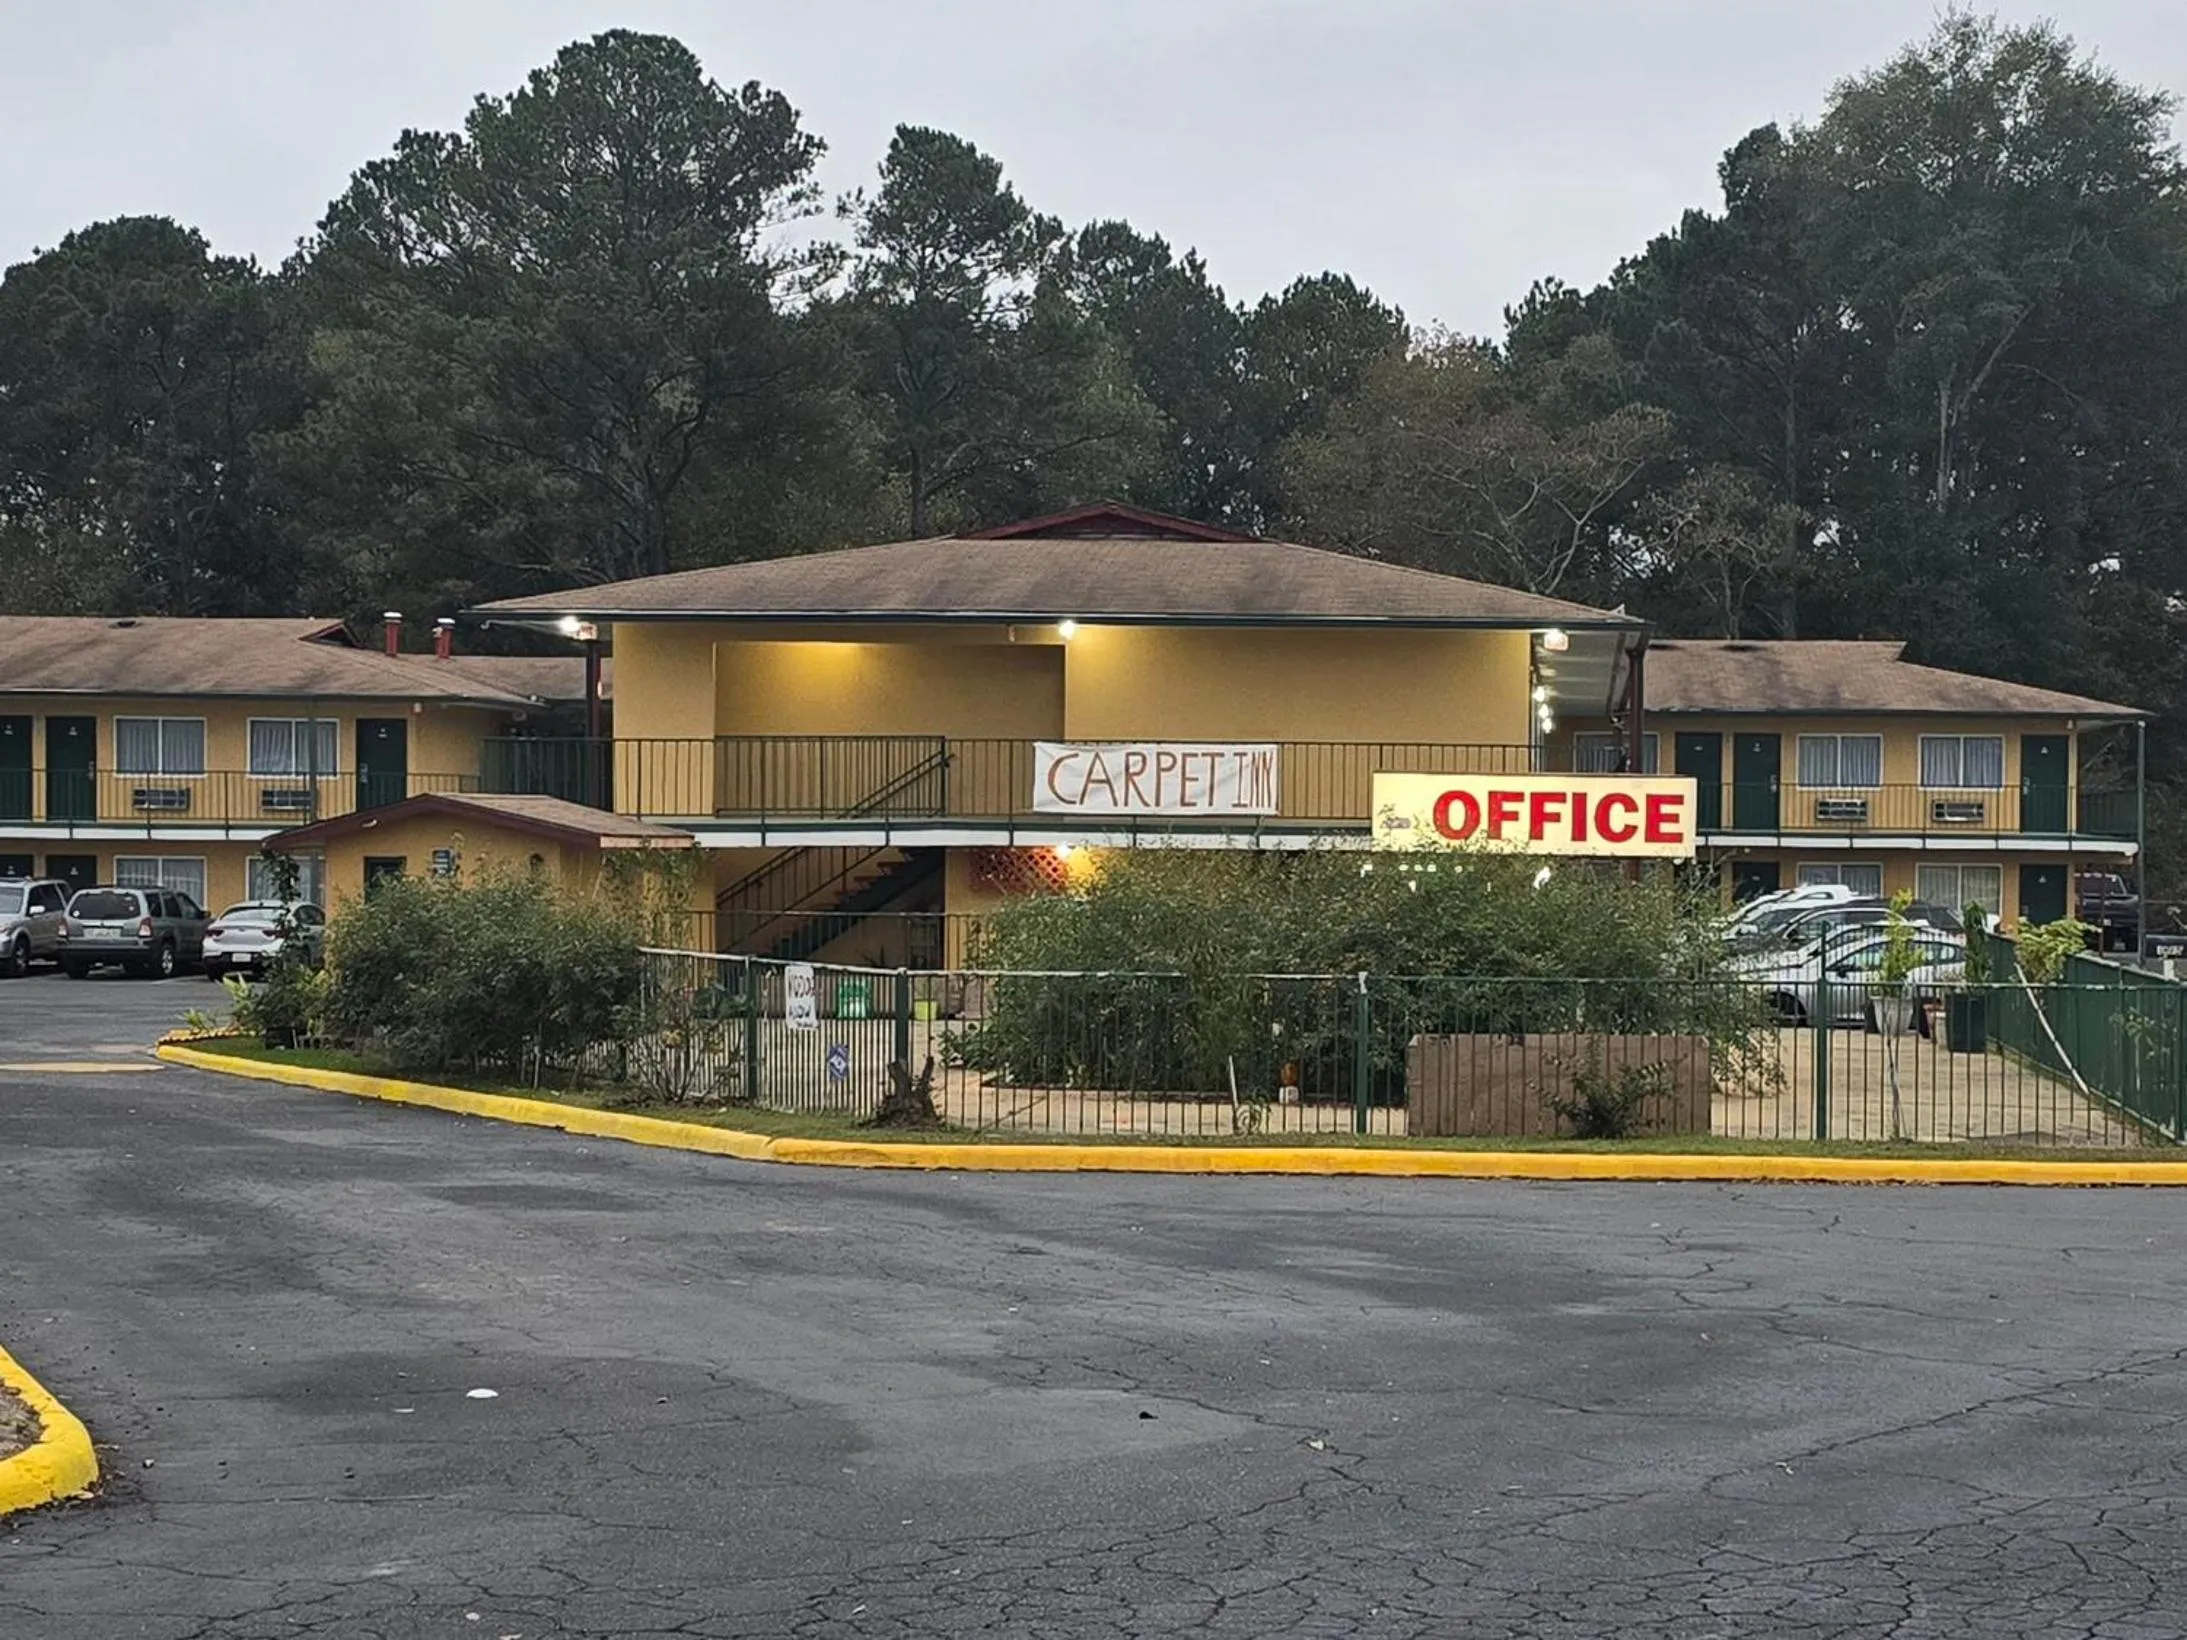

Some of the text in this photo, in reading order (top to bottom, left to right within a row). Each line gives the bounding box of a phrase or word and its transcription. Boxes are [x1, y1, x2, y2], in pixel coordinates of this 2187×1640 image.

[1047, 751, 1274, 809] CARPET INN
[1432, 789, 1685, 843] OFFICE
